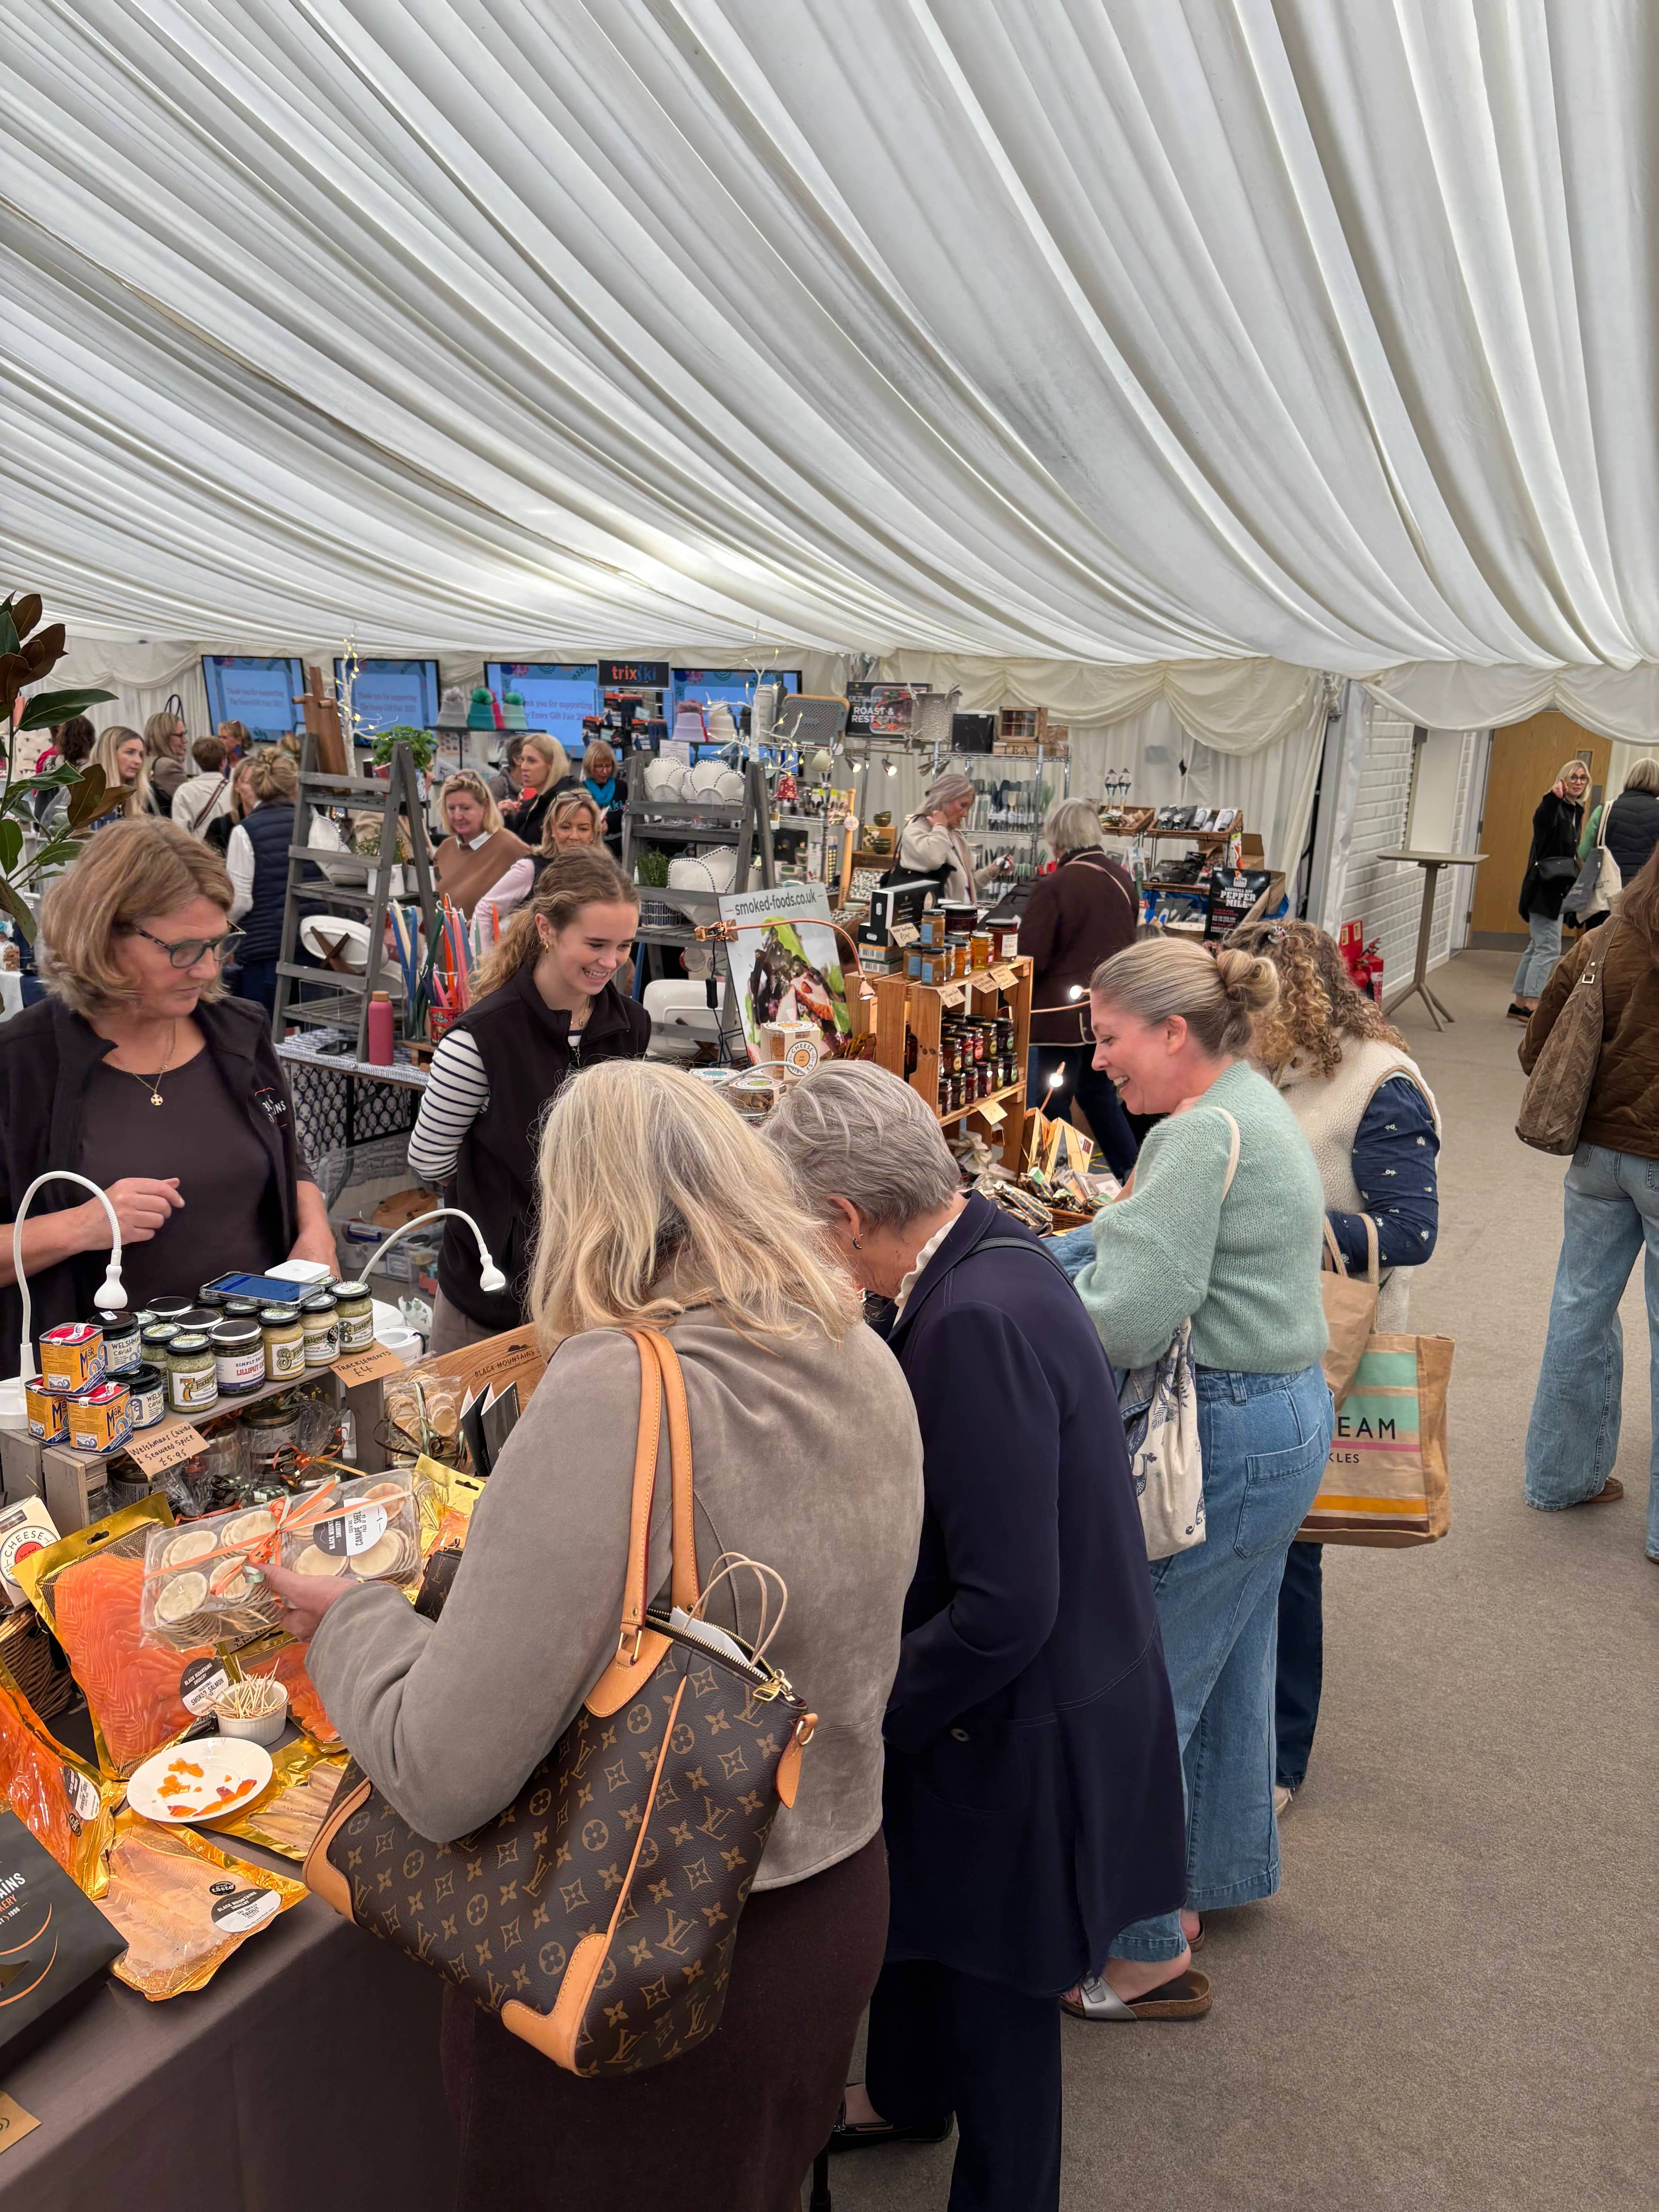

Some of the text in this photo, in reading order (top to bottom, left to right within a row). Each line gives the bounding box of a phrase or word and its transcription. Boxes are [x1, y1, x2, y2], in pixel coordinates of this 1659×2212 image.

[854, 706, 895, 716] ROAST &
[852, 715, 876, 723] REST
[1001, 746, 1029, 755] TEA
[1220, 890, 1256, 902] PEPPER
[735, 889, 817, 916] smoked-foods.co.uk
[1225, 899, 1248, 909] MILL
[791, 1043, 814, 1054] CHEESE
[113, 1347, 132, 1356] CAVIAR
[334, 1350, 392, 1371] TRACKLEMENTS
[474, 1365, 495, 1377] BLACK
[497, 1350, 534, 1369] MOUNTAINS
[236, 1364, 259, 1376] LILLIPUT
[353, 1365, 373, 1377] £4
[129, 1434, 171, 1456] Welshmans
[170, 1425, 191, 1438] Caviar
[353, 1510, 362, 1524] SHEL
[4, 1530, 45, 1558] CHEESE
[184, 1662, 213, 1686] BLACK MOUNTAINS
[208, 1677, 225, 1693] SALMON
[216, 1891, 258, 1912] BLACK MOUNTAINS
[8, 1906, 21, 1917] 1996
[241, 1906, 260, 1917] TROUT
